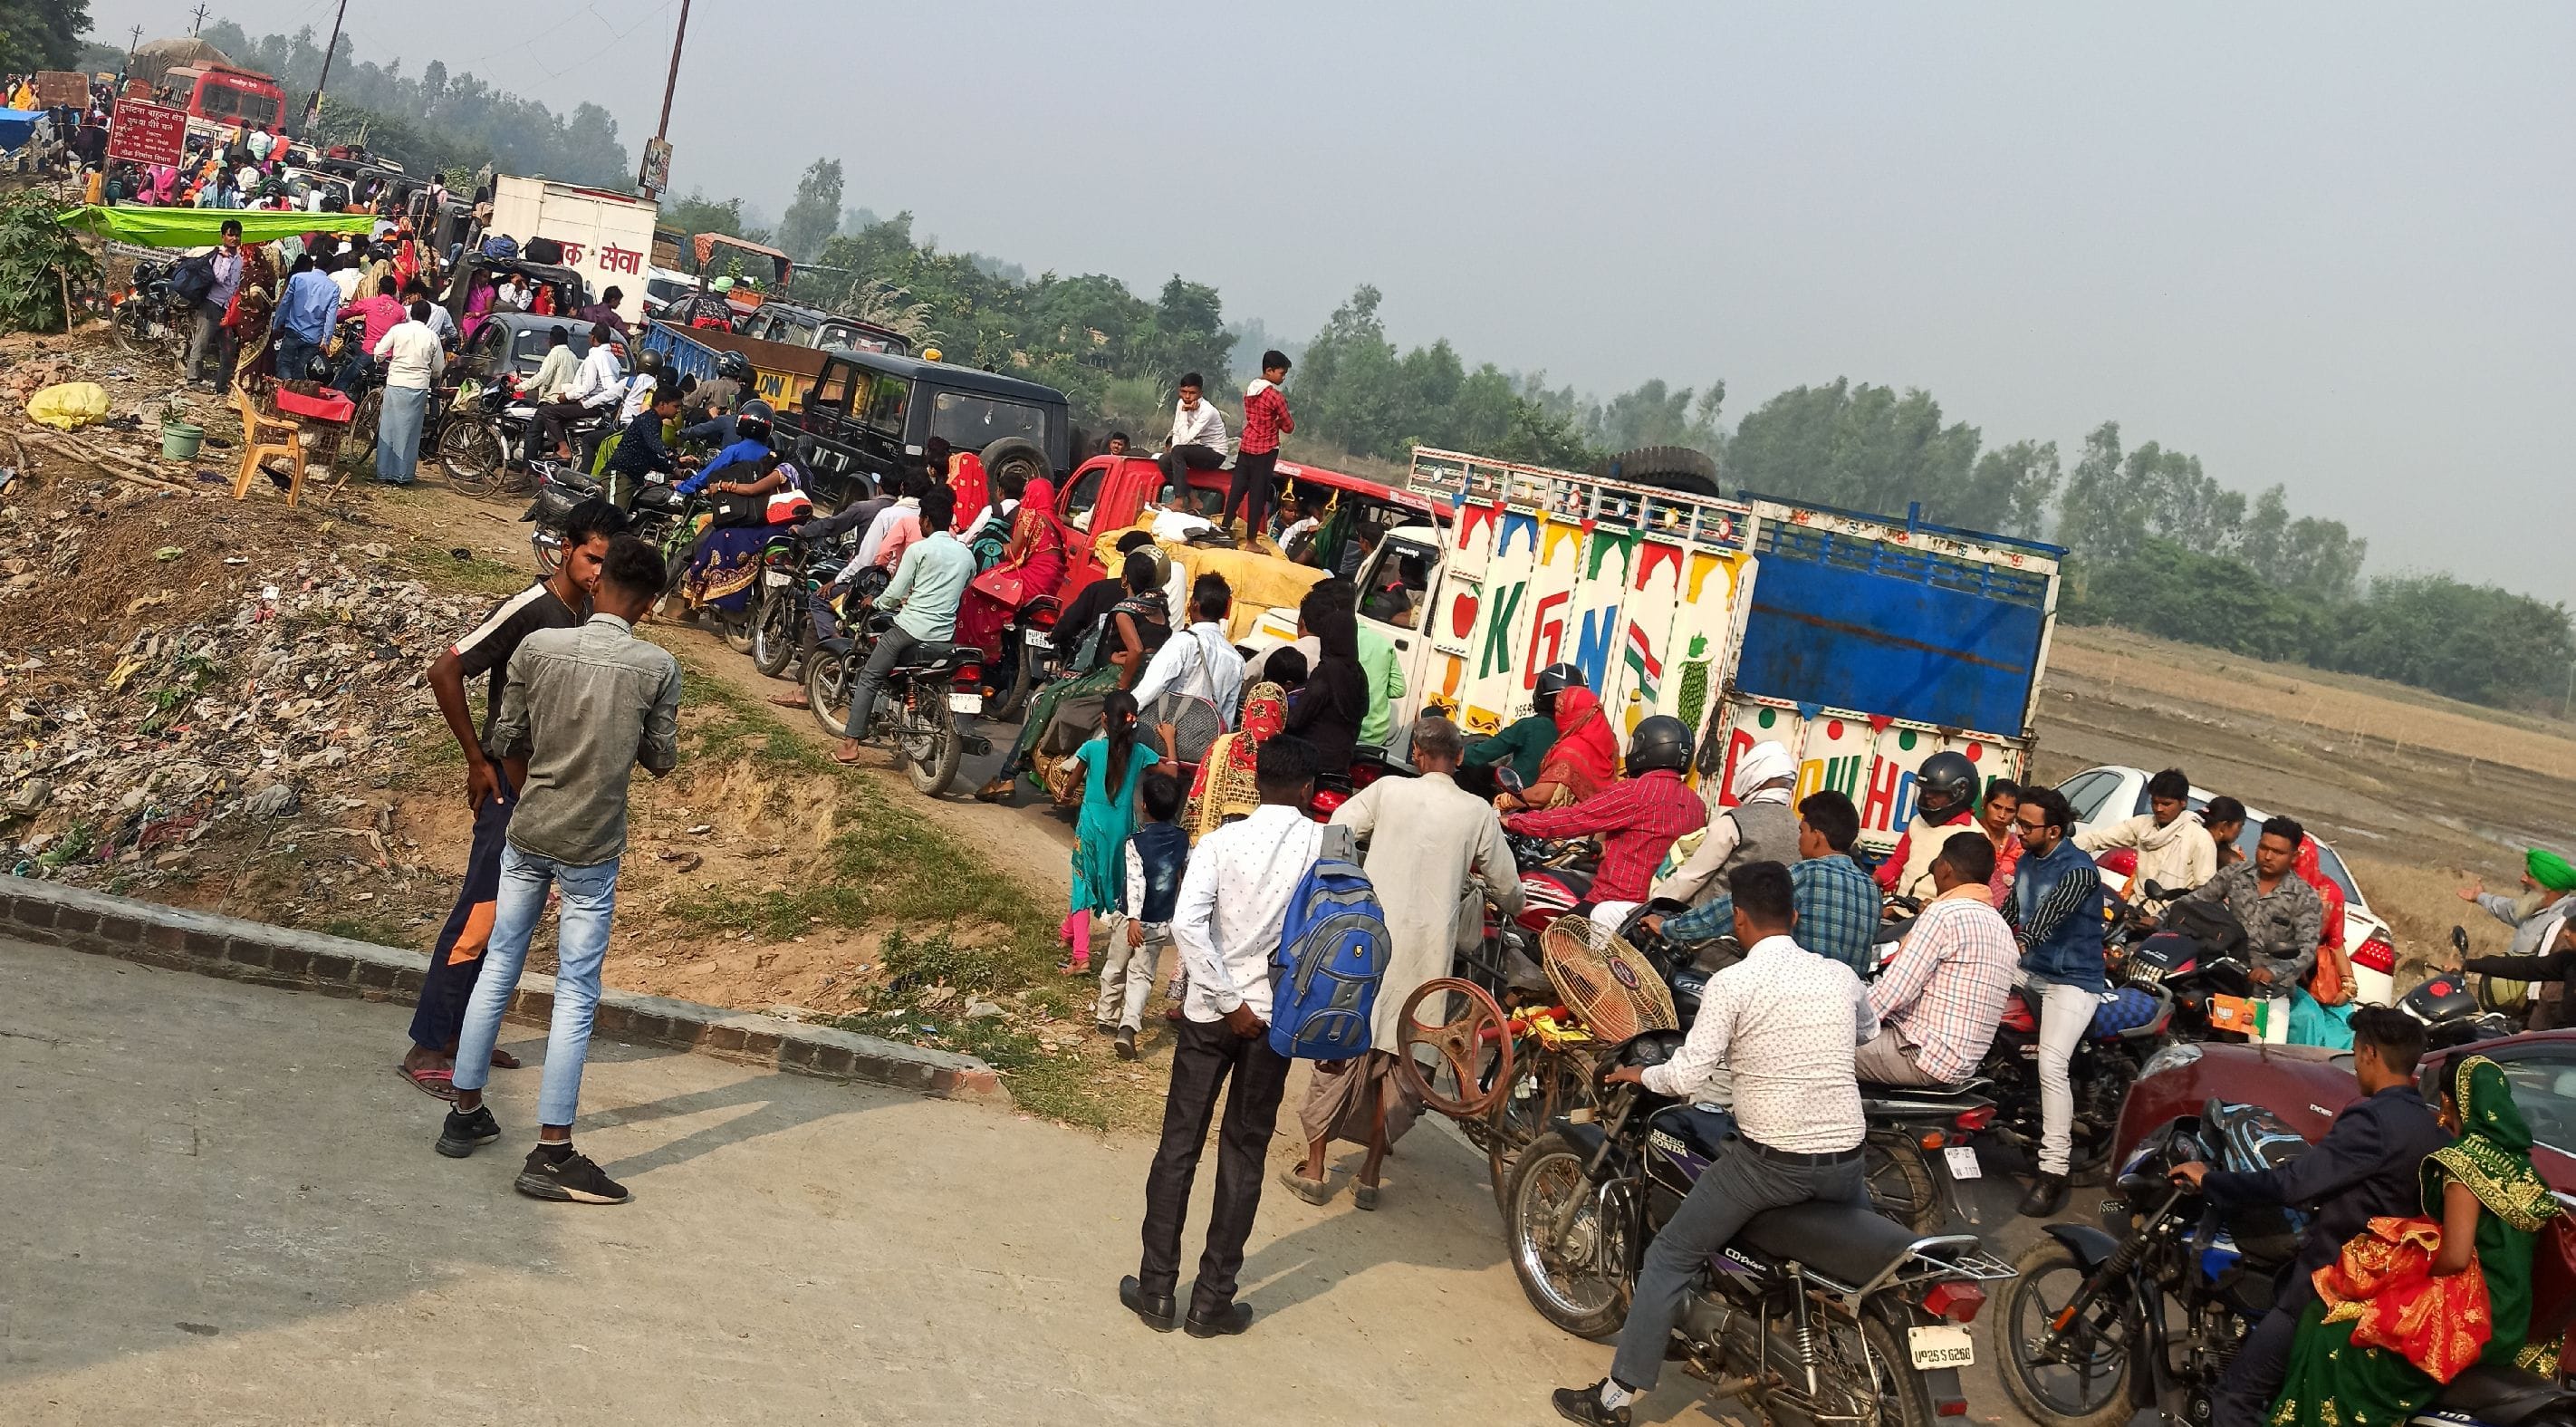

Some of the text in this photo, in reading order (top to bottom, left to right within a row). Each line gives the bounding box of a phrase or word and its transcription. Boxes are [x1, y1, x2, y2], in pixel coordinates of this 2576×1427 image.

[120, 103, 146, 115] दुर्घटना
[171, 111, 185, 122] क्षेत्र
[600, 241, 644, 275] सेवा
[1649, 1133, 1689, 1159] HONDA
